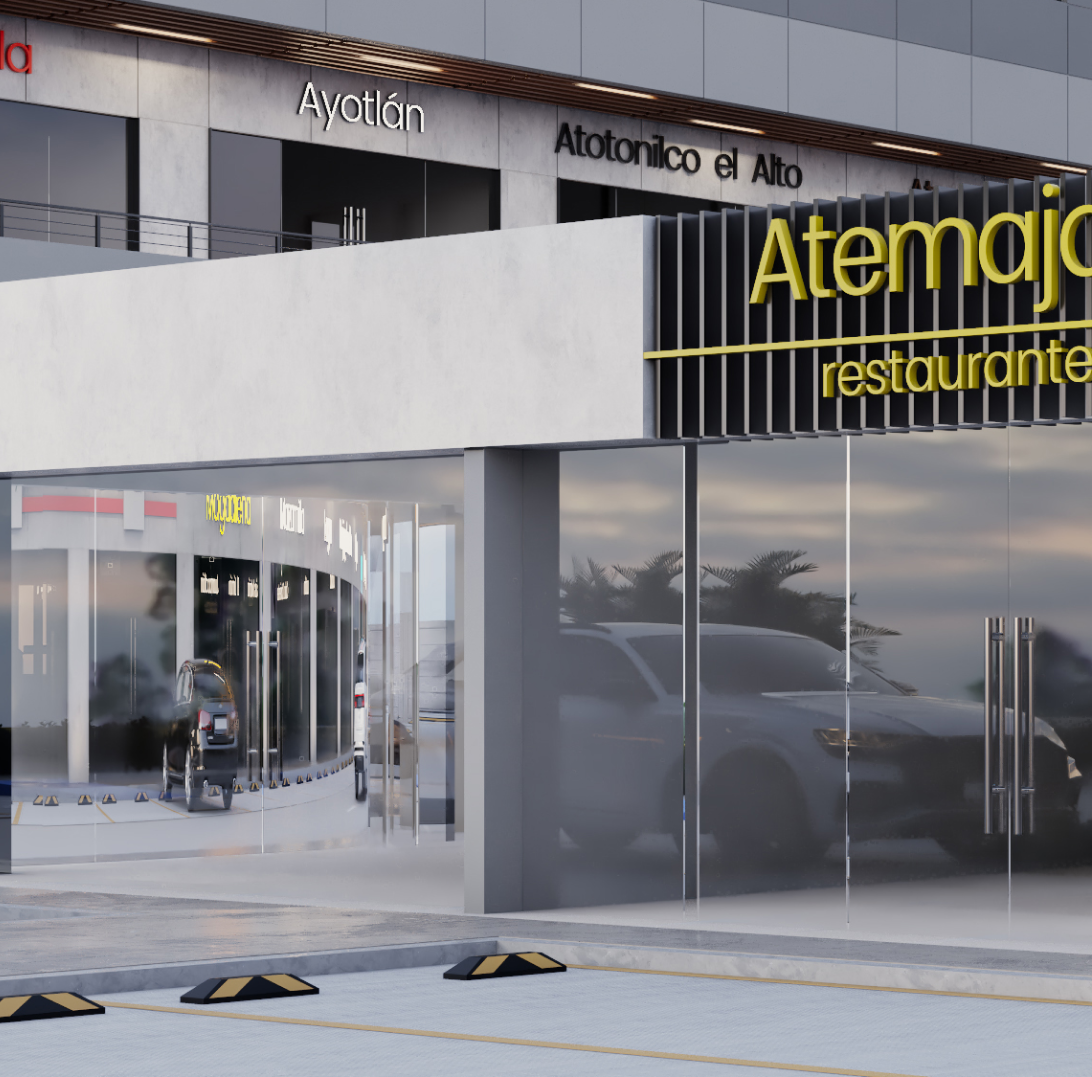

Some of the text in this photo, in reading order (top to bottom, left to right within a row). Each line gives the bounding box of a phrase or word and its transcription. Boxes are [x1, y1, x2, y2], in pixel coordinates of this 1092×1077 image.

[298, 81, 425, 132] Ayotlán
[554, 122, 803, 189] Atotonilco el Alto
